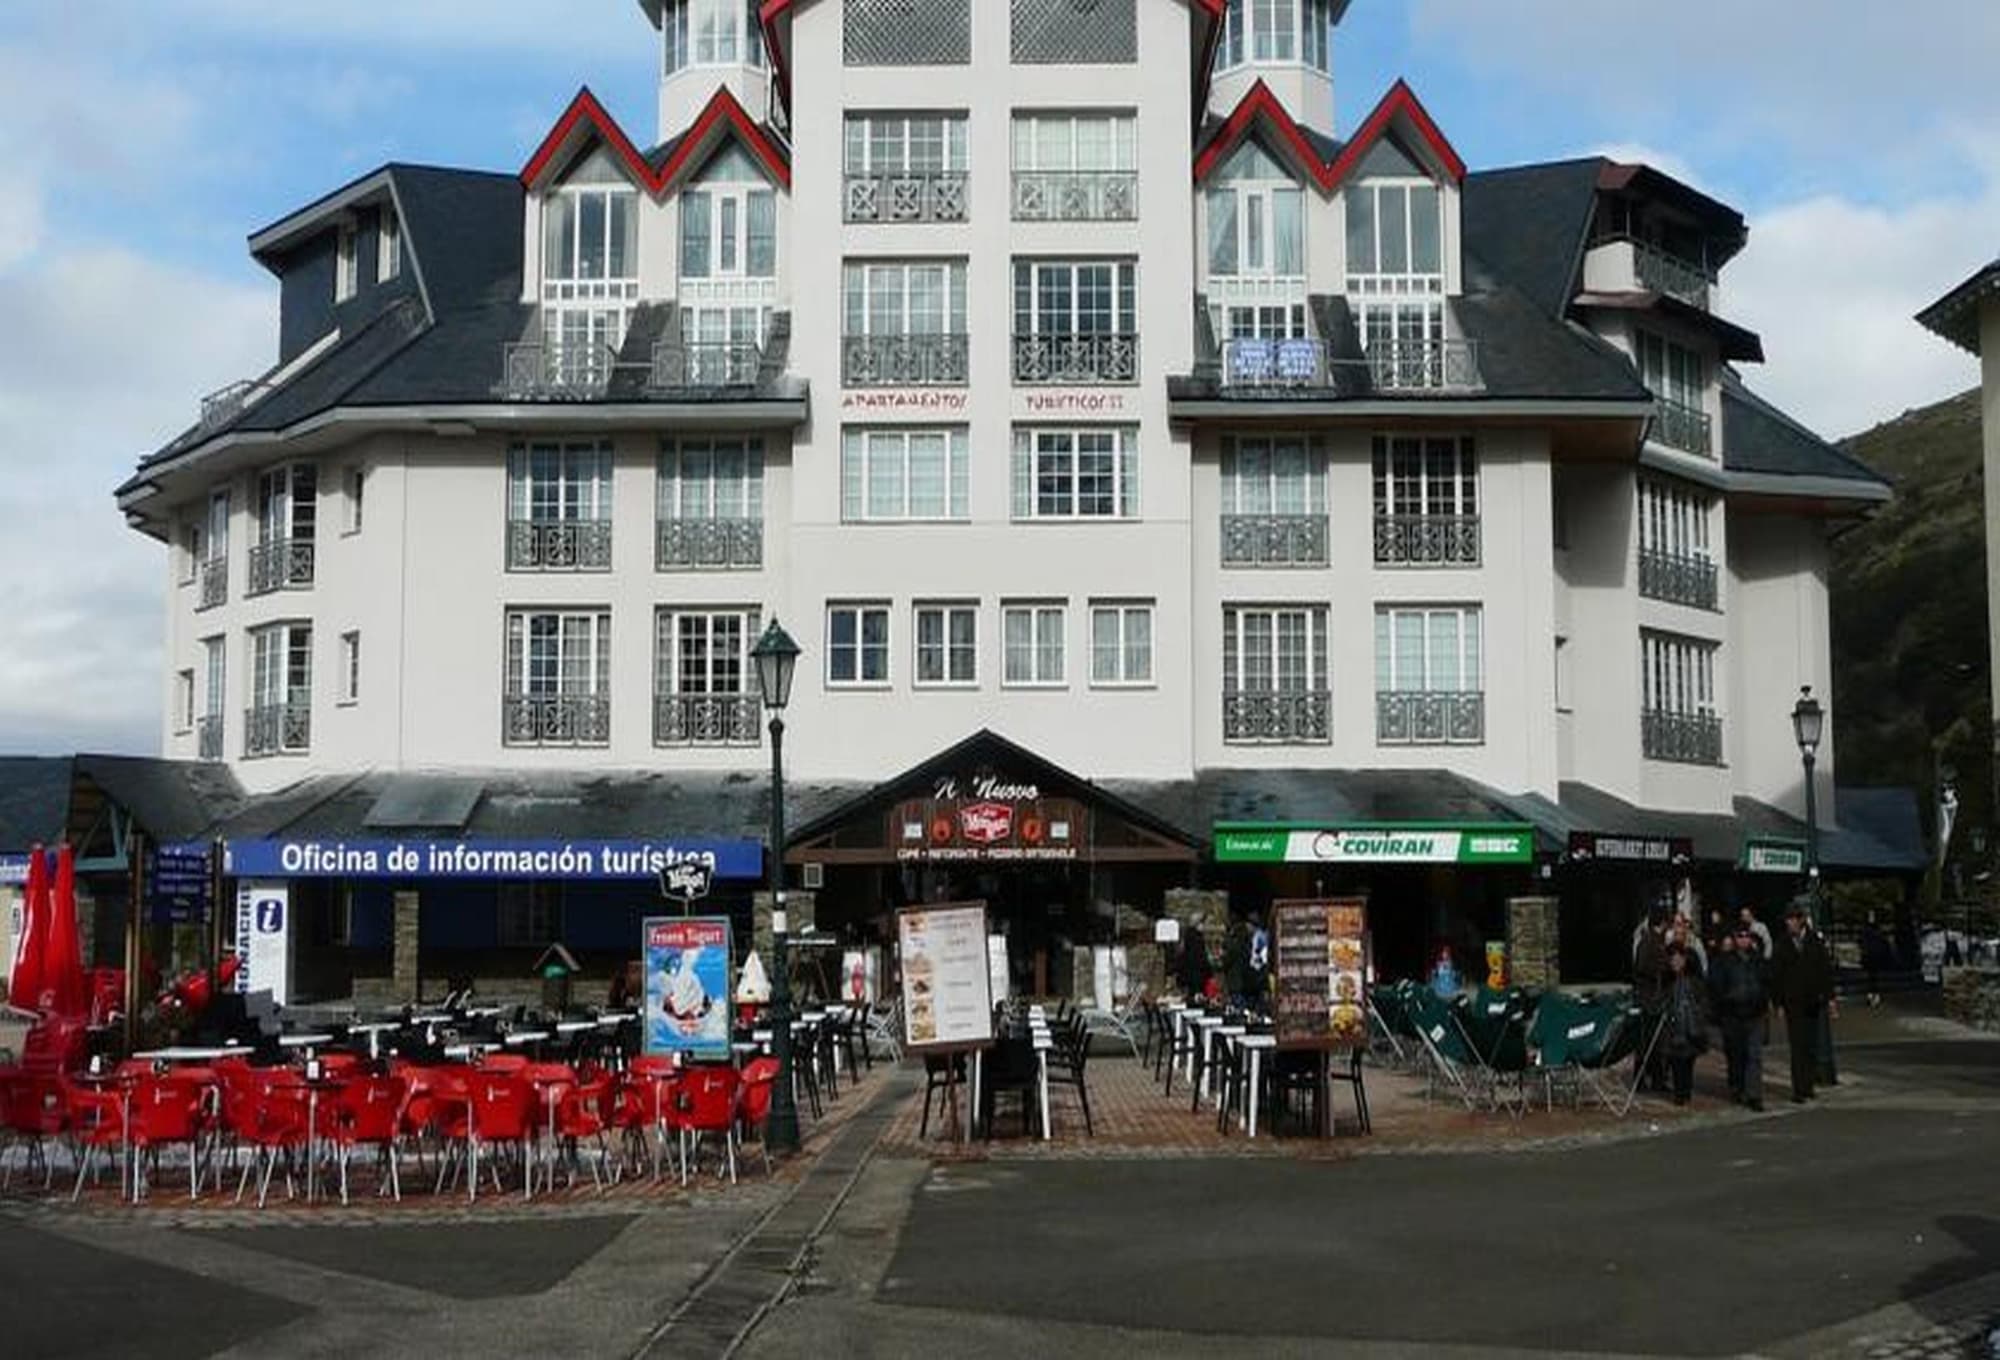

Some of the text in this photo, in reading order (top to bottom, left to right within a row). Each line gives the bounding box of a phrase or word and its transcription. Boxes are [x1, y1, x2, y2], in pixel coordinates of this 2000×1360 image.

[281, 843, 378, 871] Oficina
[387, 844, 419, 871] de
[429, 843, 593, 873] información
